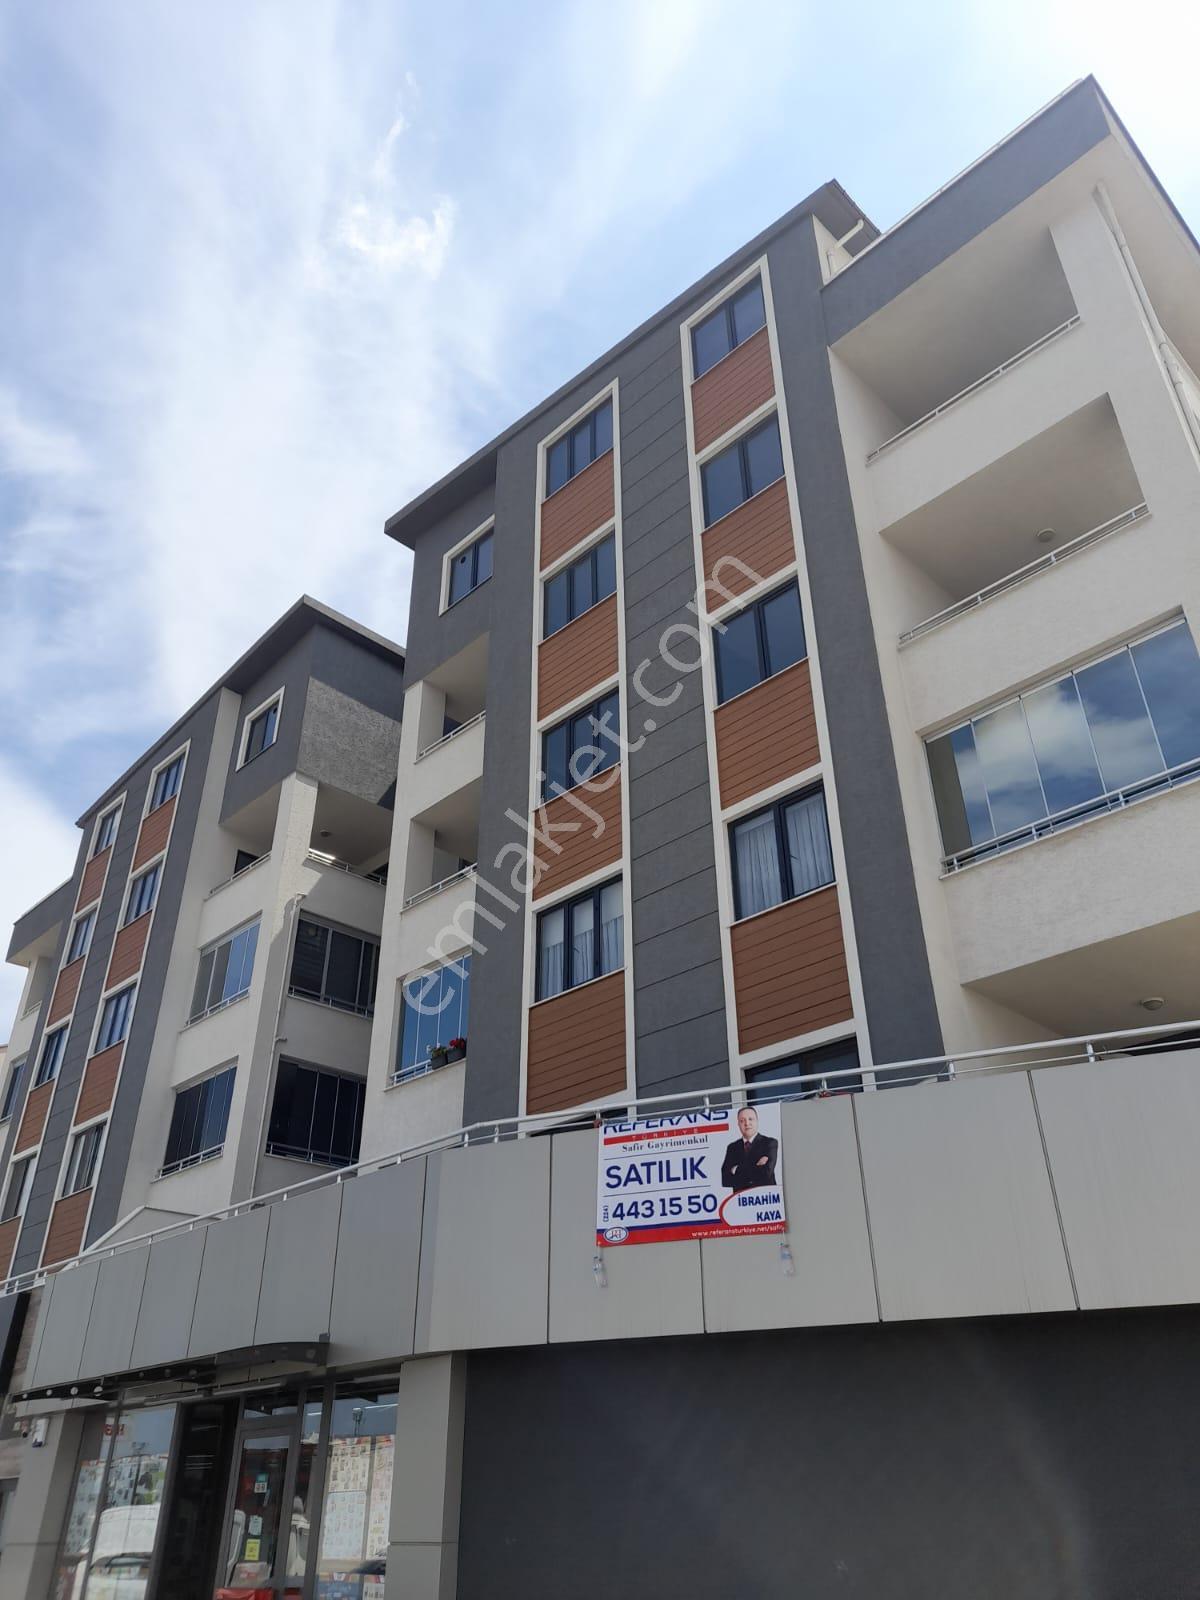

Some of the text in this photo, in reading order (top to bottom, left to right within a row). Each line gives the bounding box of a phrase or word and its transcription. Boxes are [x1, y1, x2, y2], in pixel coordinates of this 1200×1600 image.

[622, 1135, 709, 1153] Safir Gayrimenkul
[605, 1155, 707, 1189] SATILIK
[612, 1193, 718, 1221] 443 15 50
[738, 1191, 781, 1207] İBRAHİM
[756, 1210, 782, 1222] KAYA
